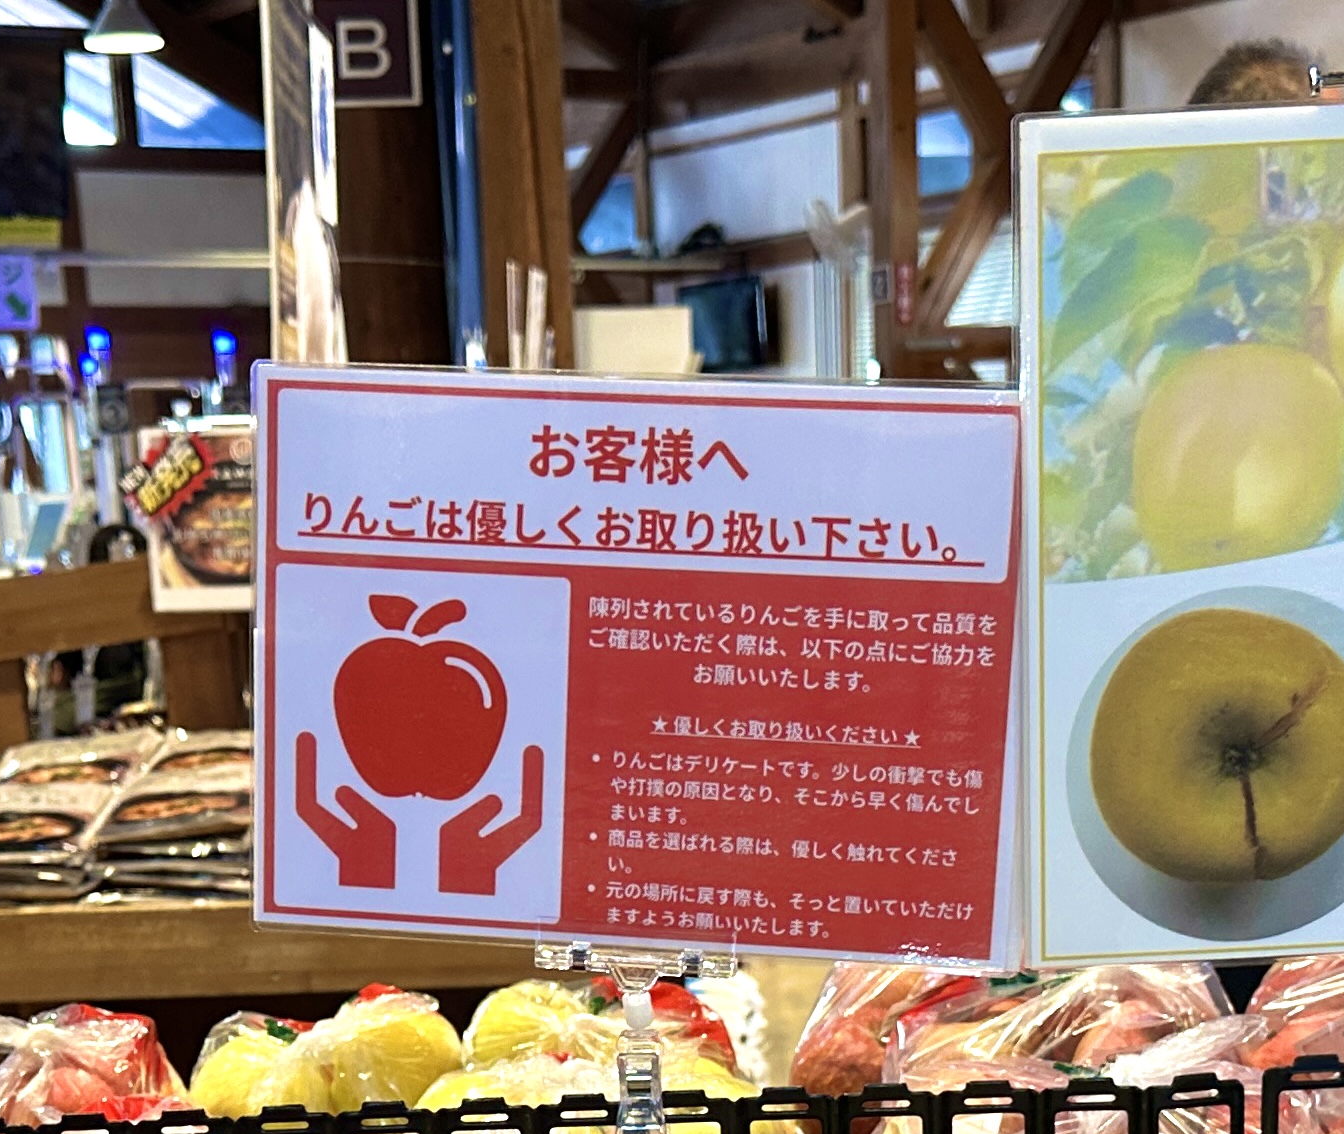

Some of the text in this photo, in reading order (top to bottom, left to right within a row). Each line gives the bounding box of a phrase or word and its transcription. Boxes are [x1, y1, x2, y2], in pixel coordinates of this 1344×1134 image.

[336, 19, 392, 79] B
[528, 425, 750, 485] お客様へ
[304, 492, 957, 564] りんごは優しくお取り扱い下さい。
[588, 596, 998, 637] 陳列されているりんごを手に取って品質を
[588, 627, 996, 668] ご確認いただく際は、以下の点にご協力を
[693, 663, 871, 693] お願いいたします。
[610, 803, 687, 826] まいます。
[608, 857, 633, 875] い。
[606, 906, 830, 938] ますようお願いいたします。
